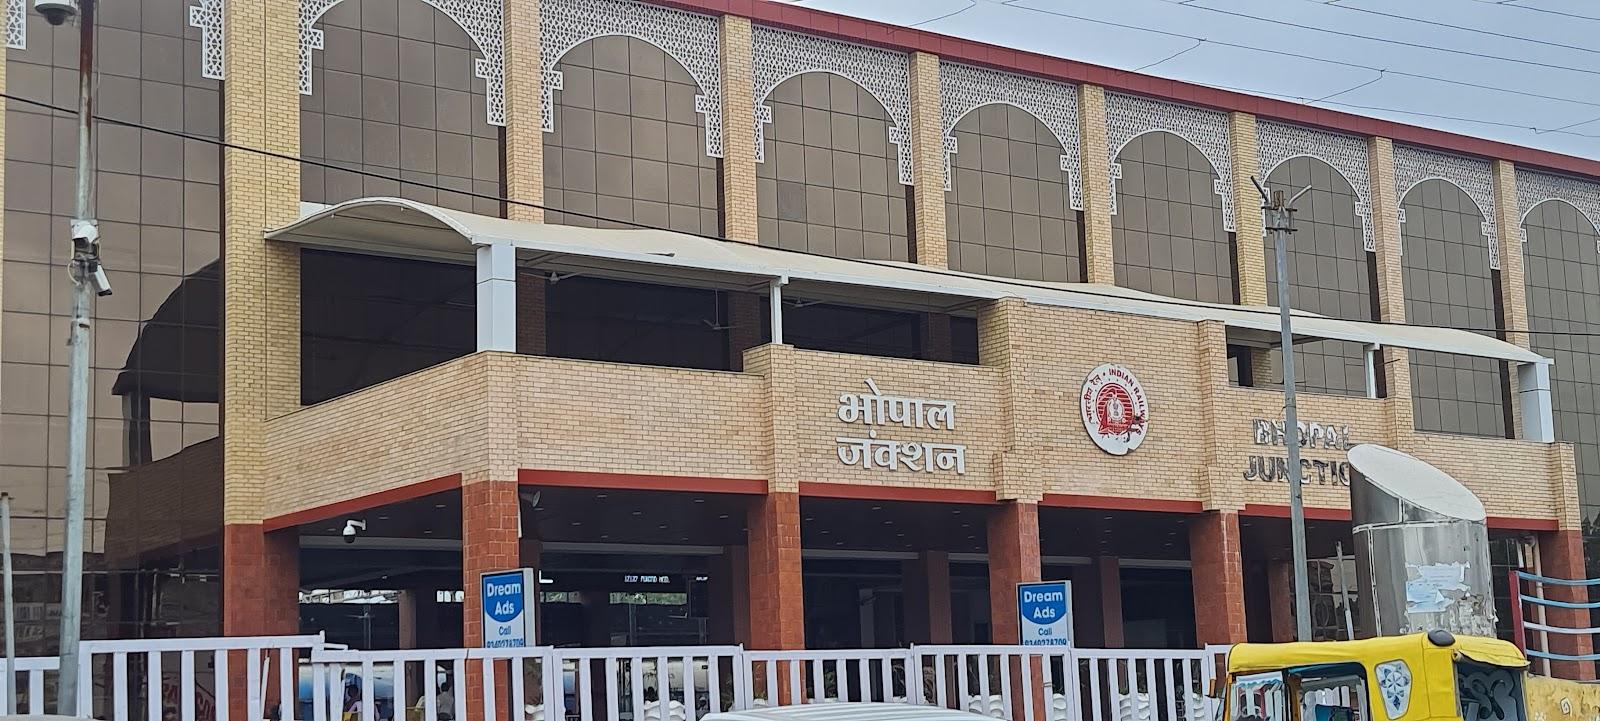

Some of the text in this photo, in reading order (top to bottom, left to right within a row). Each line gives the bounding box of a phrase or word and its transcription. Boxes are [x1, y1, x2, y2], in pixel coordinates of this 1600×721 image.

[1108, 368, 1134, 387] INDIAN
[838, 377, 956, 430] भोपाल
[836, 429, 966, 474] जंक्शन
[1243, 456, 1350, 486] JUNCTIO
[486, 583, 521, 597] Dream
[1024, 591, 1063, 603] Dream
[495, 600, 515, 615] Ads
[1033, 606, 1056, 619] Ads
[498, 625, 512, 636] Call
[1038, 627, 1053, 636] Call
